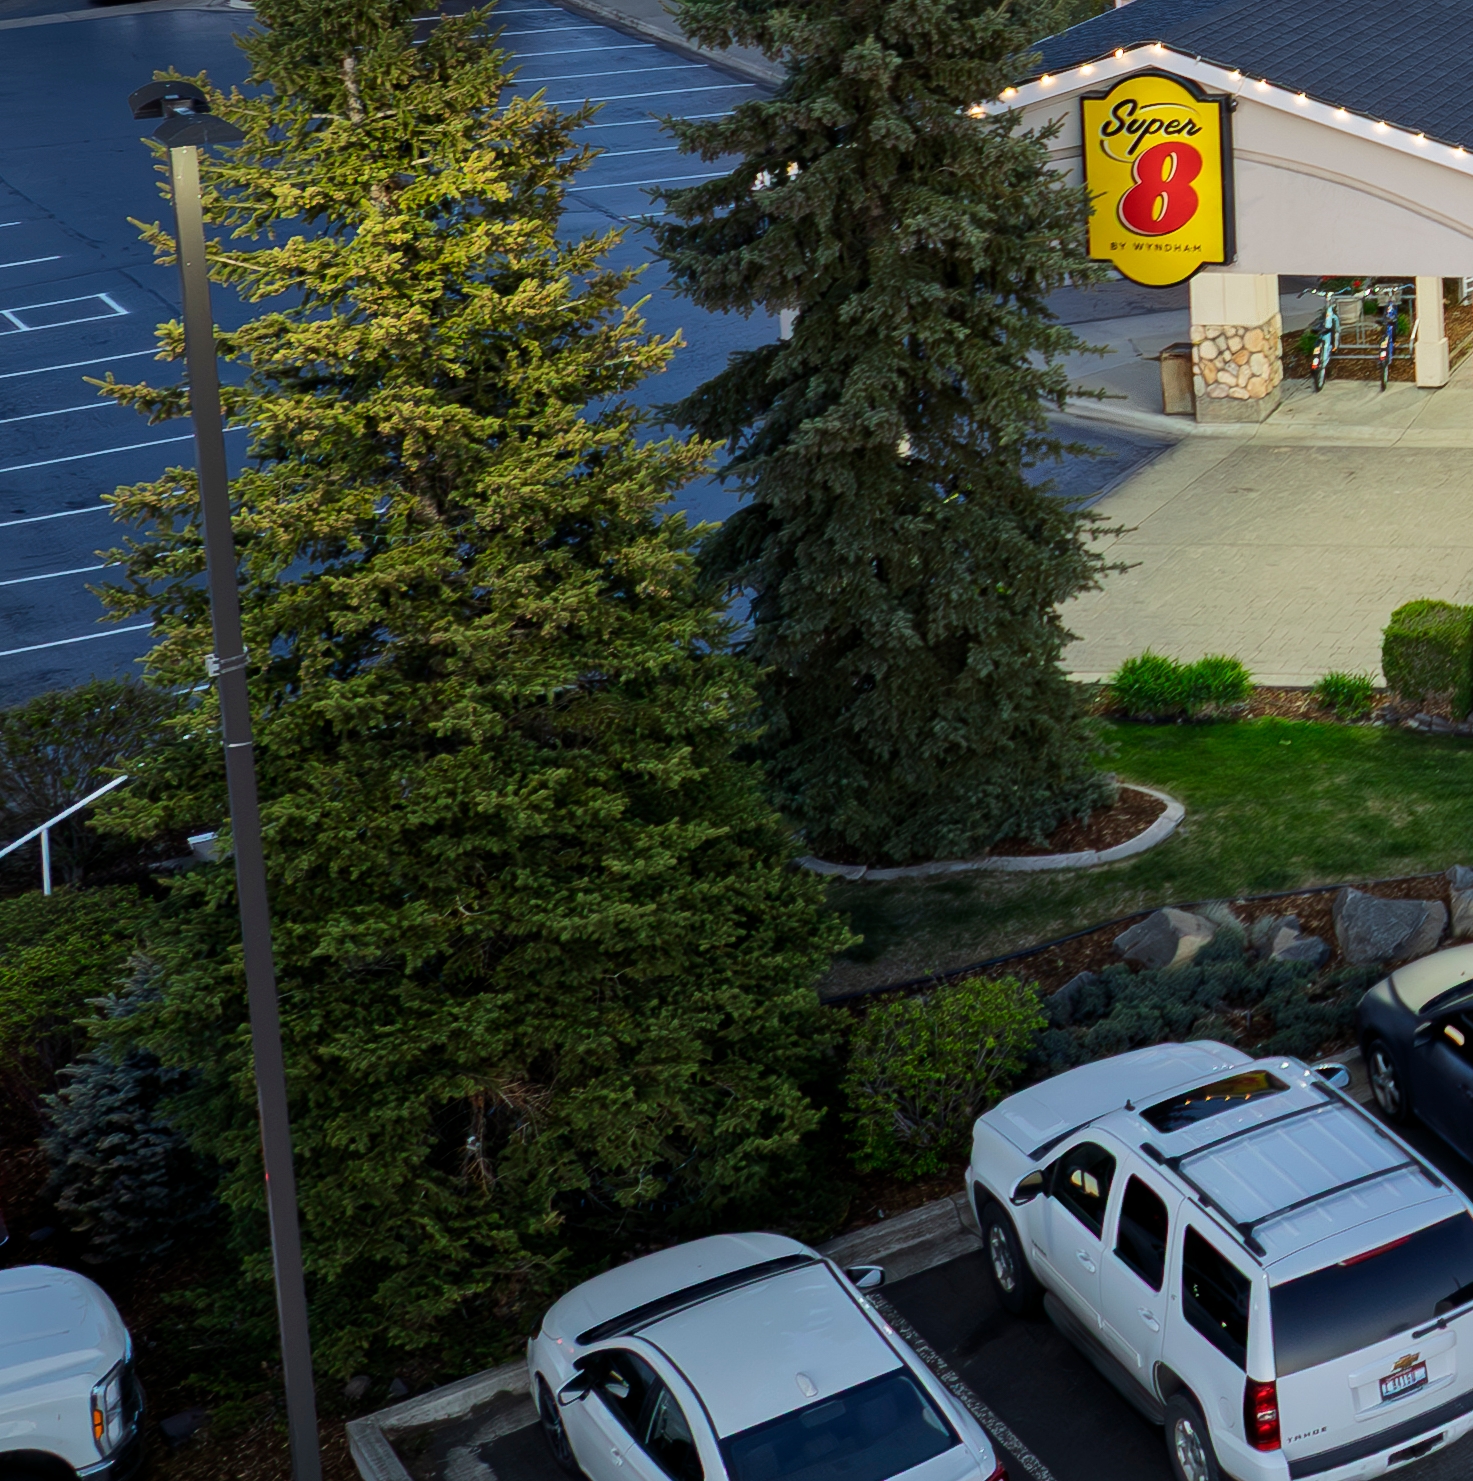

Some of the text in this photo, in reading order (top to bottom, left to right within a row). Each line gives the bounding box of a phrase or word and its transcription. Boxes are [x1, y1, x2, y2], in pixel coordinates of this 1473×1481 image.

[1101, 98, 1202, 156] Super
[1117, 141, 1203, 237] 8
[1110, 241, 1203, 254] BY WYNDHAM
[1287, 1426, 1327, 1443] TAHOE
